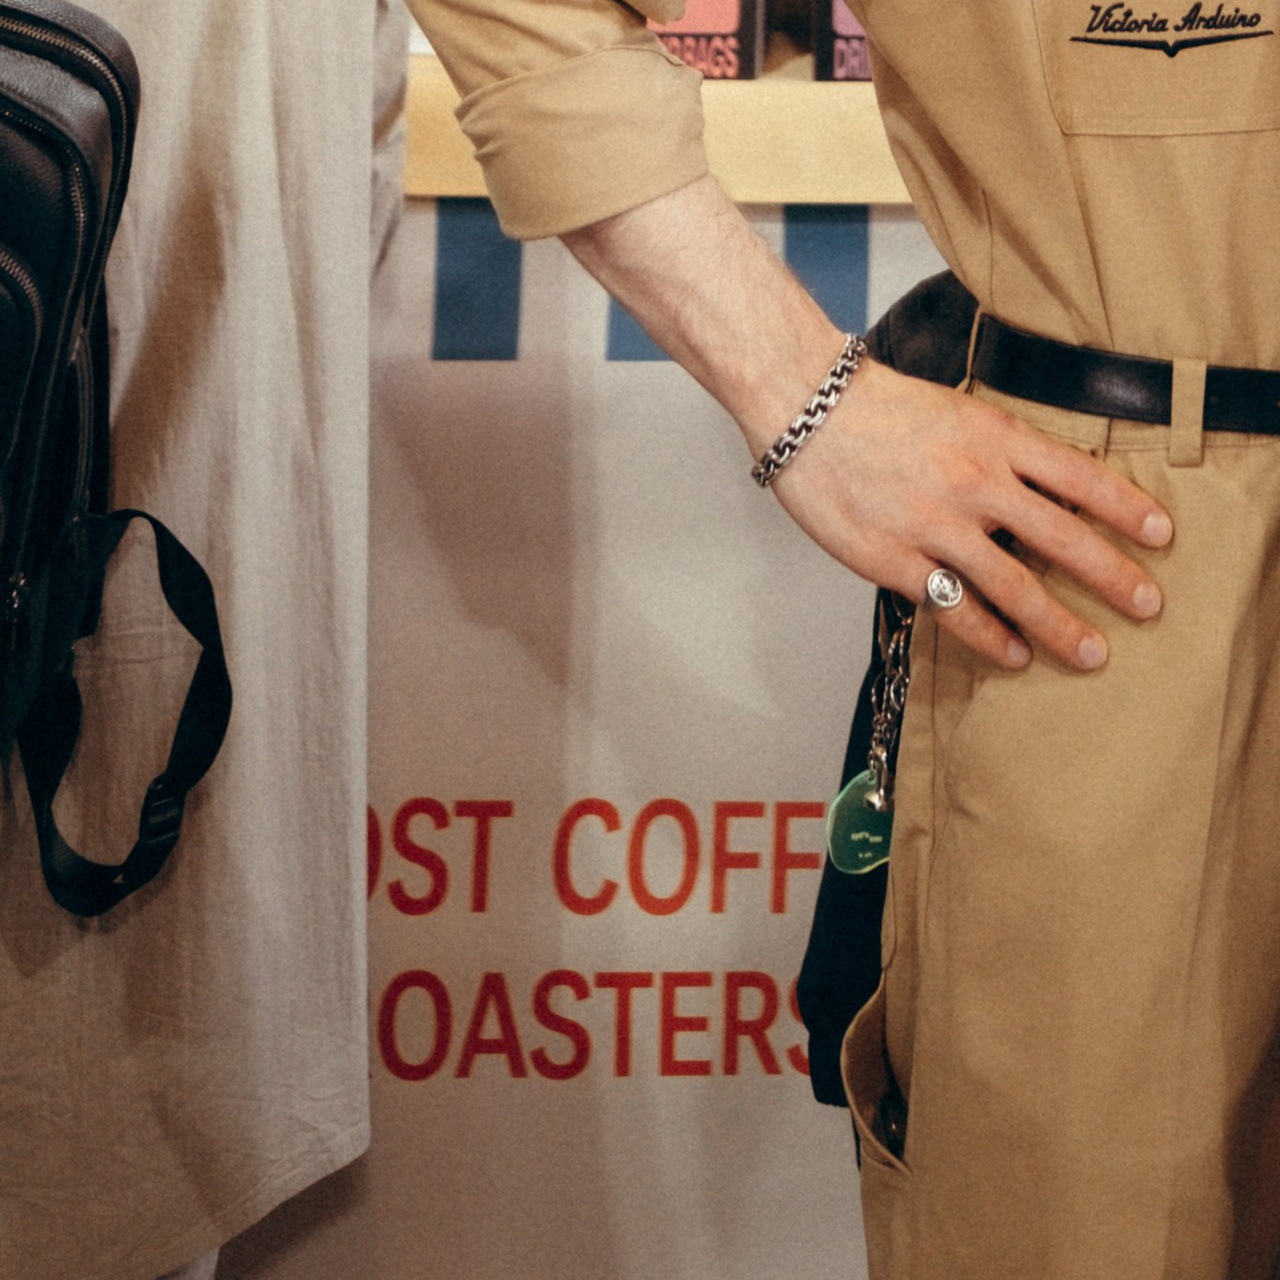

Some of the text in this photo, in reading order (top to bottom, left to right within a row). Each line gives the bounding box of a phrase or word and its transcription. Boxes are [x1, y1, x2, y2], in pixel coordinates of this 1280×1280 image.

[1086, 2, 1261, 33] Victoria Arduino
[368, 796, 514, 916] ST
[368, 969, 811, 1081] OASTER
